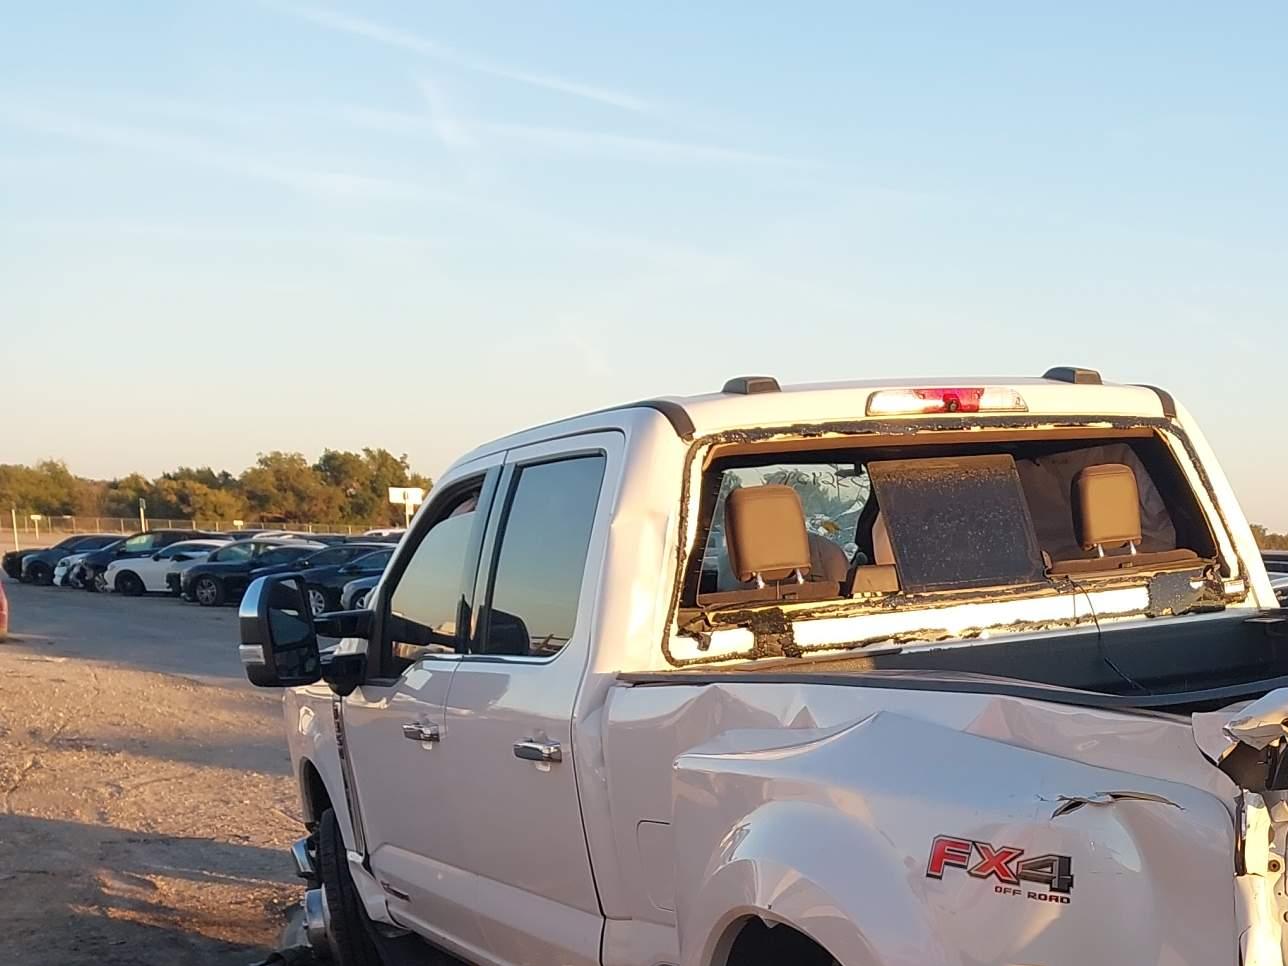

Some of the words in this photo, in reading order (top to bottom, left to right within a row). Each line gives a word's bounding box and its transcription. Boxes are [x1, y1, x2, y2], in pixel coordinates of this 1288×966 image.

[926, 834, 1074, 894] FX4
[994, 885, 1022, 897] OFF
[1027, 891, 1071, 904] ROAD
